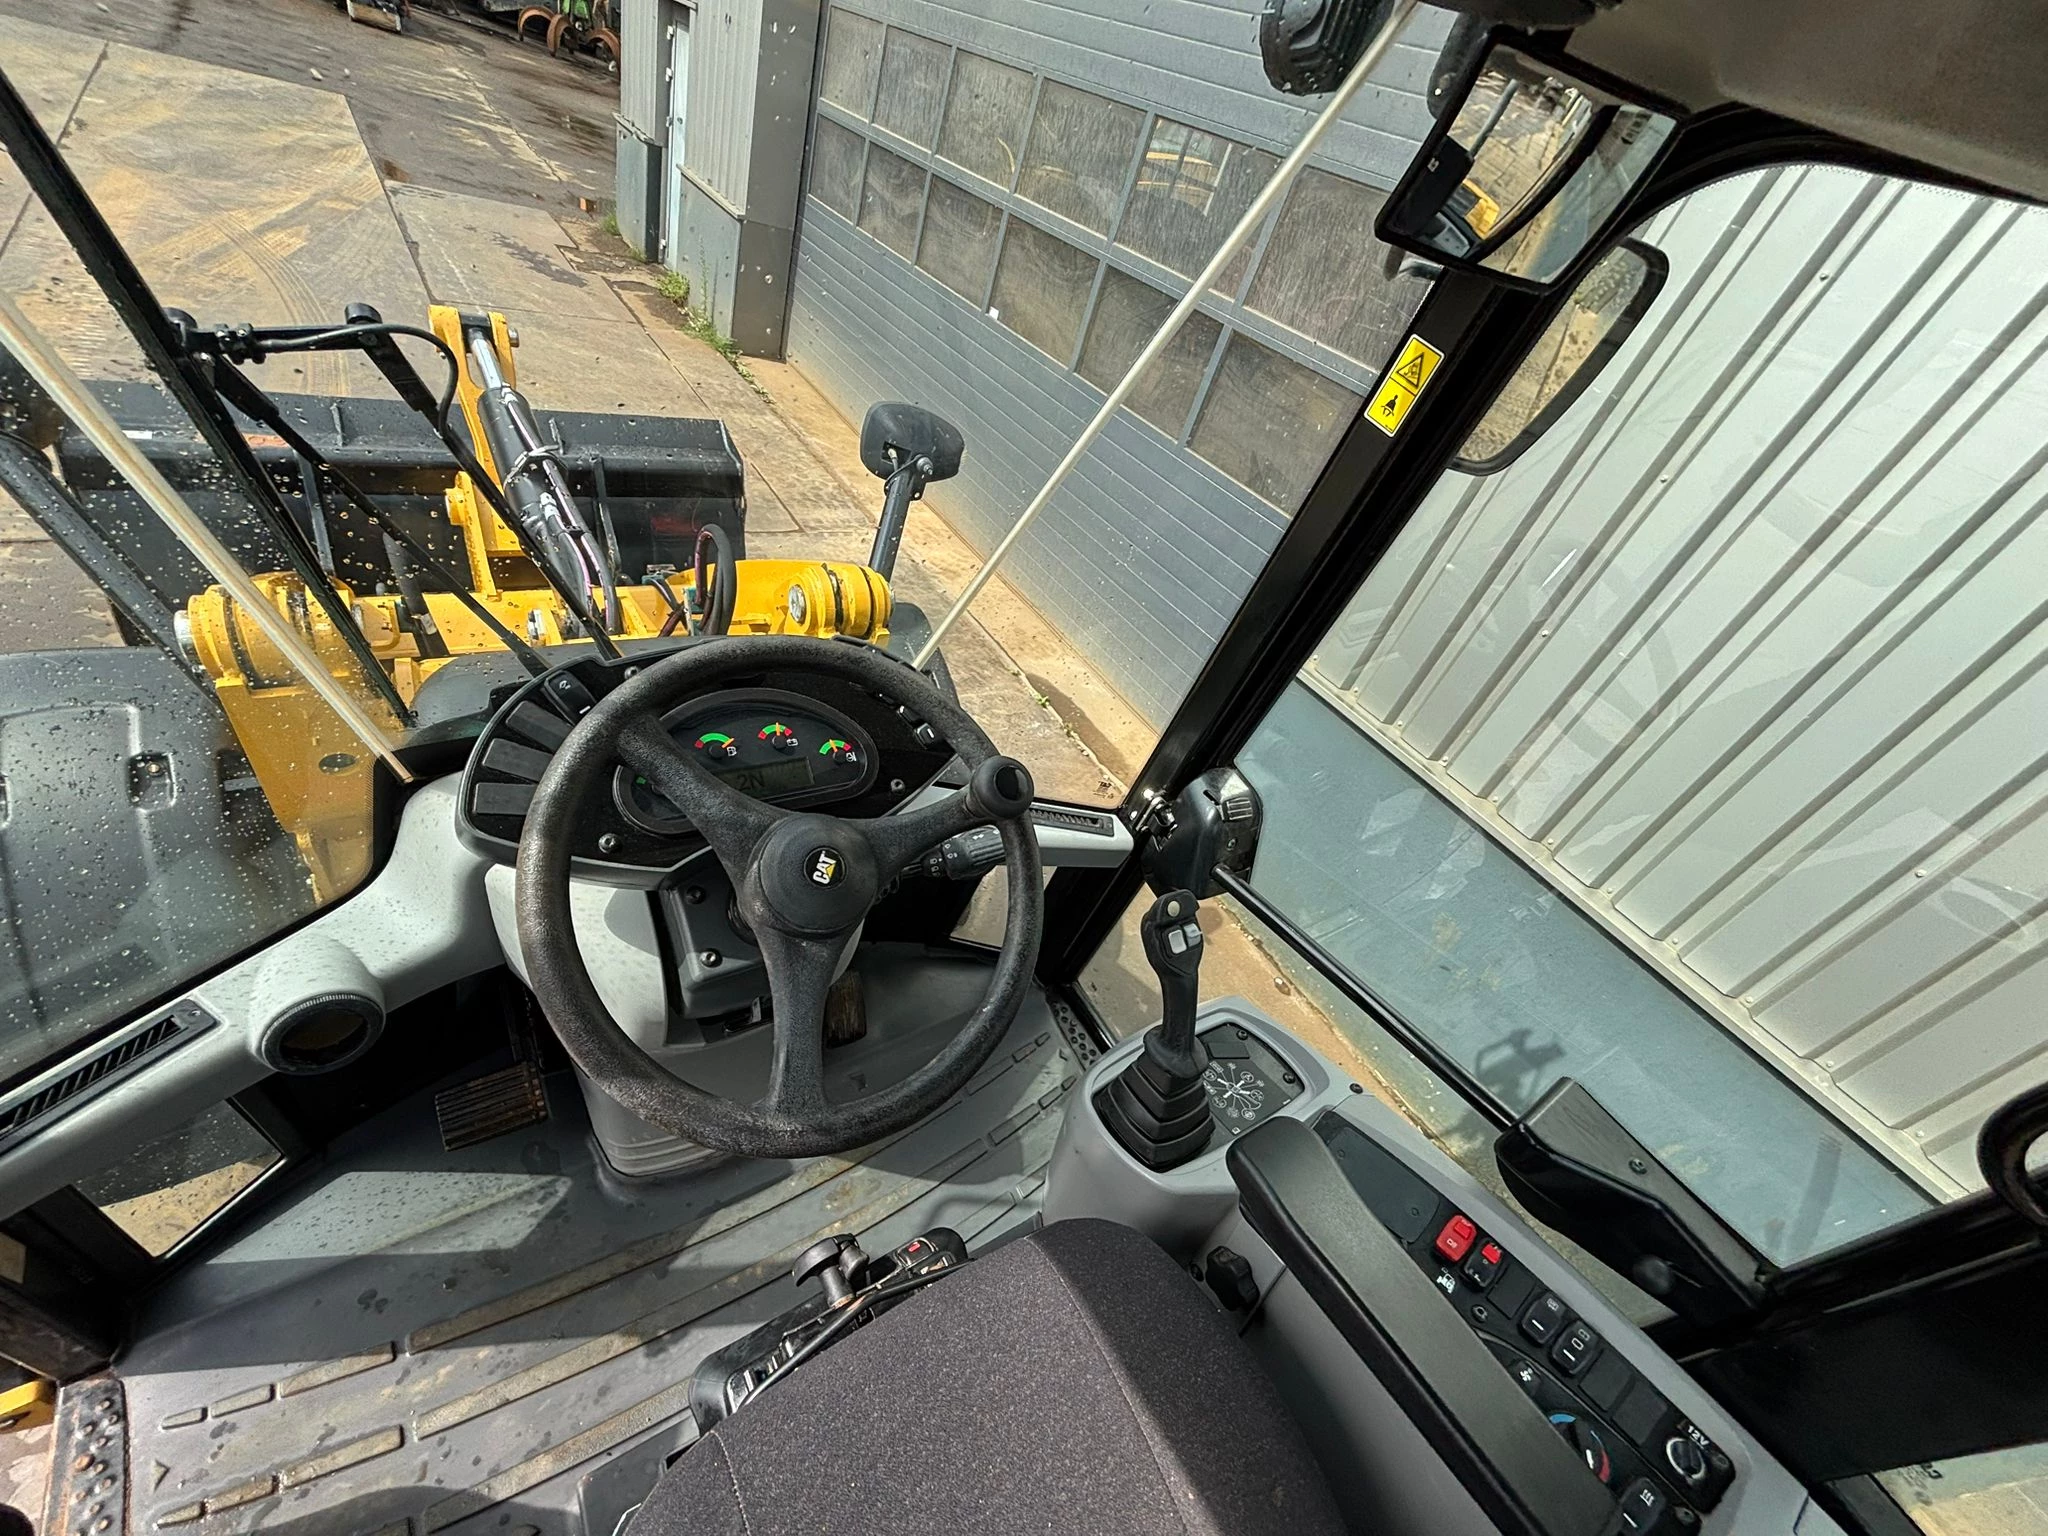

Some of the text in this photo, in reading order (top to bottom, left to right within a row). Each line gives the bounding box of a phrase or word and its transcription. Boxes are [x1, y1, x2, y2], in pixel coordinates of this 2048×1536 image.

[737, 771, 765, 791] 2N
[812, 851, 837, 884] CAT
[1687, 1425, 1709, 1446] 12V
